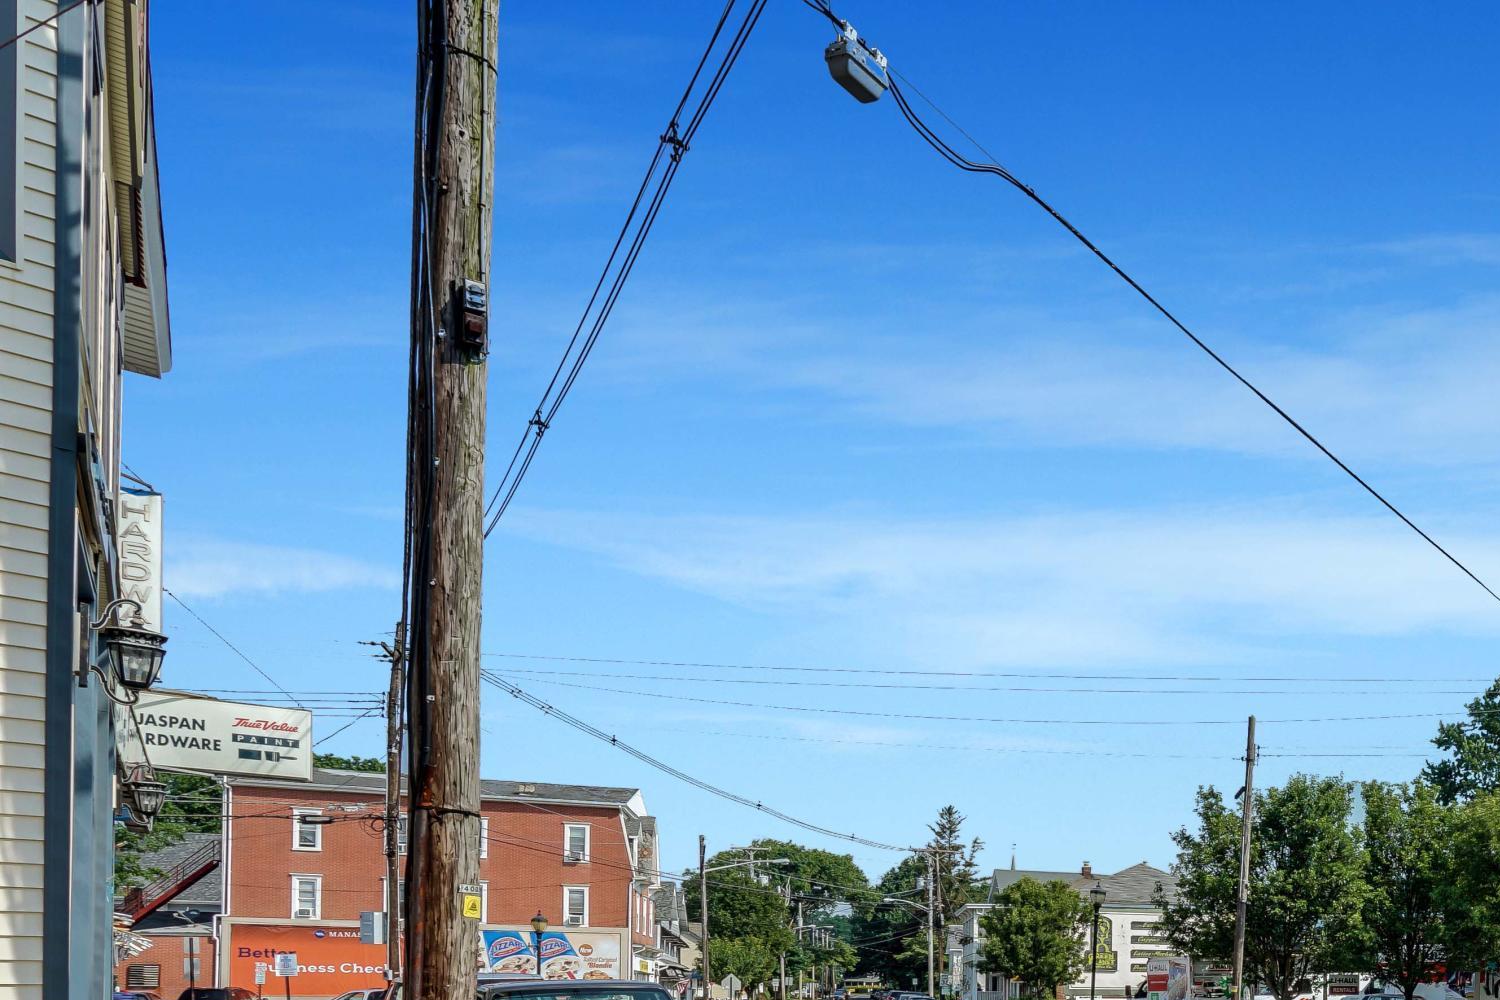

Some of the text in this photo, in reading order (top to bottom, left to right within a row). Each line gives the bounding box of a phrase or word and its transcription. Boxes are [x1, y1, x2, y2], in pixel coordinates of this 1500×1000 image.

[138, 712, 206, 731] JASPAN
[237, 735, 295, 746] PAINT
[238, 947, 297, 958] Bett
